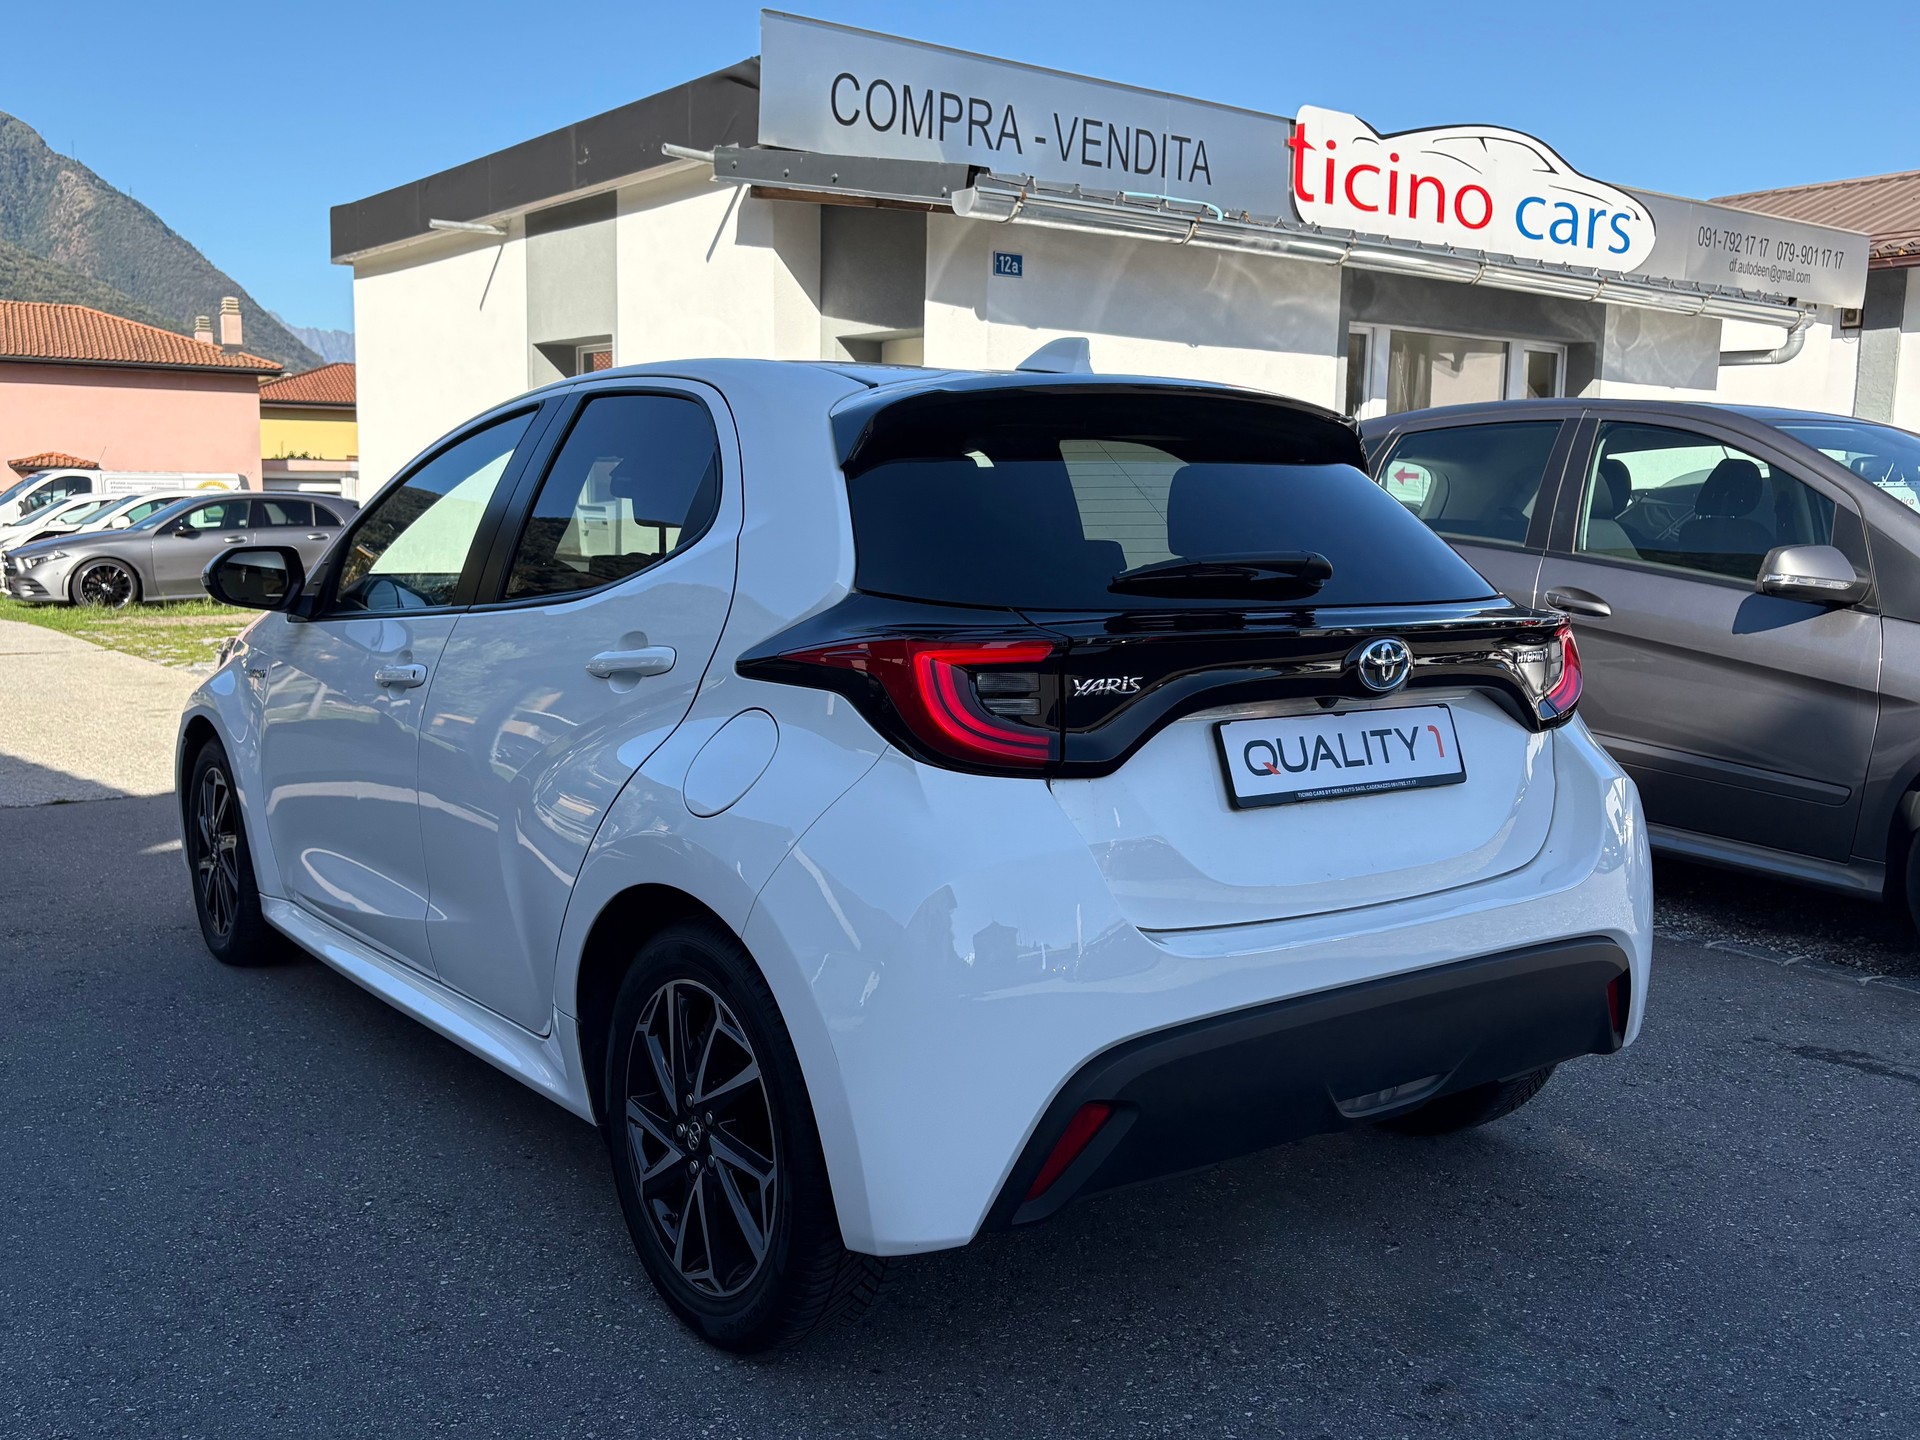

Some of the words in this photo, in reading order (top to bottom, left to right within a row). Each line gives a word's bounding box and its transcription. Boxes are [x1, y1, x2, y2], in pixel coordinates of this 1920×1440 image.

[831, 72, 1023, 155] COMPRA
[1053, 113, 1212, 186] VENDITA
[1288, 123, 1494, 230] ticino
[1515, 196, 1632, 255] cars
[999, 255, 1019, 273] 12a
[1697, 226, 1742, 253] 091-792
[1745, 234, 1756, 255] 17
[1759, 237, 1770, 258] 17
[1776, 240, 1819, 266] 079-901
[1821, 248, 1832, 268] 17
[1834, 251, 1845, 270] 17
[1728, 258, 1811, 284] df.autodeen@gmail.com
[1243, 726, 1419, 777] QUALITY
[1427, 725, 1445, 758] 1
